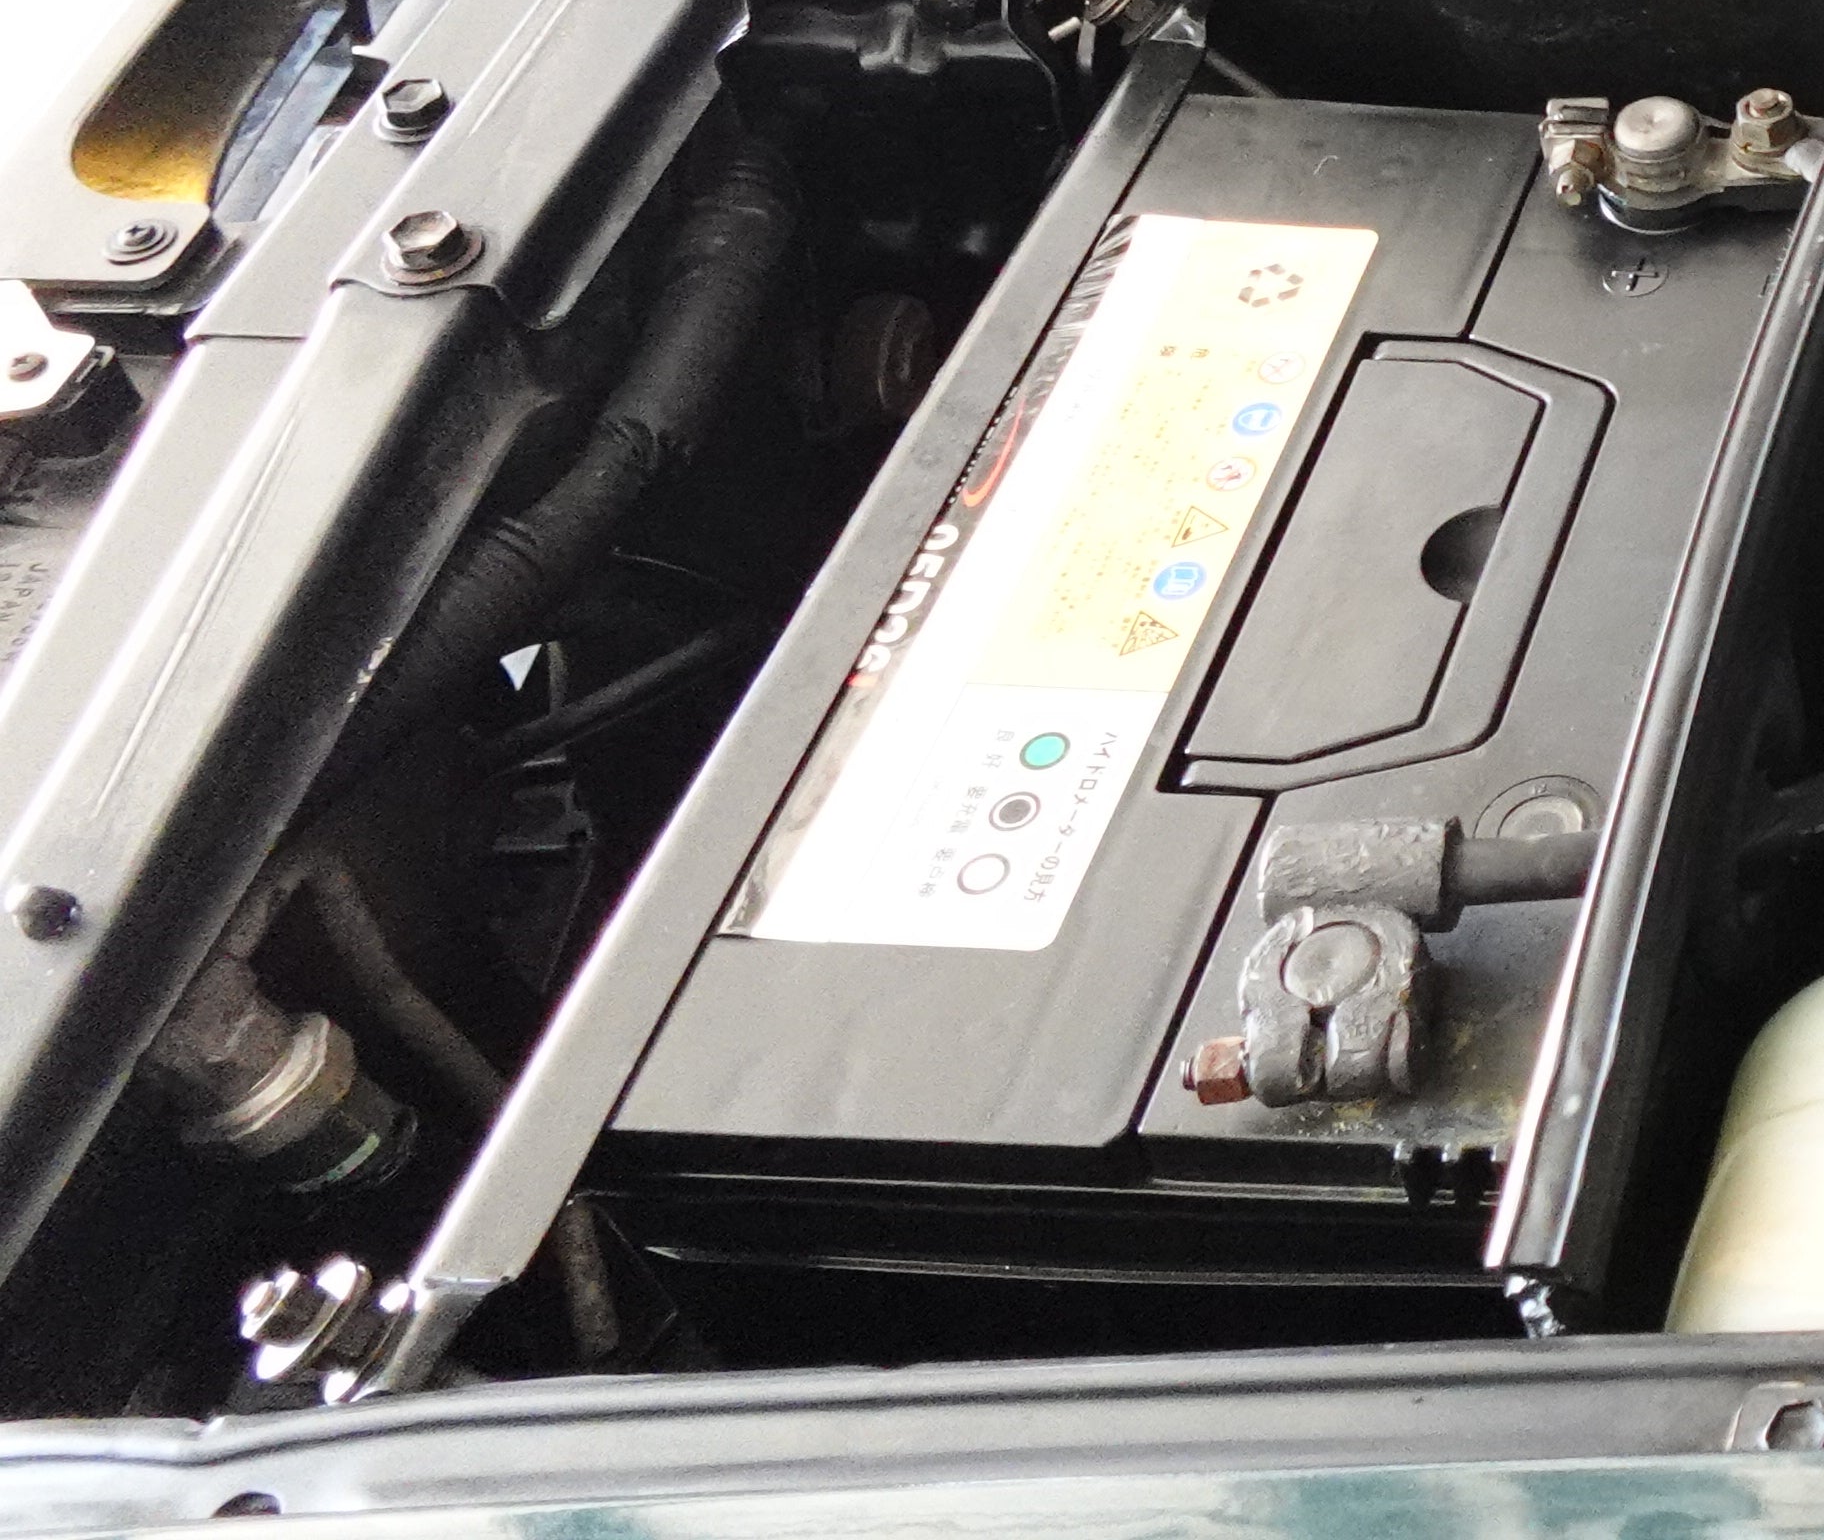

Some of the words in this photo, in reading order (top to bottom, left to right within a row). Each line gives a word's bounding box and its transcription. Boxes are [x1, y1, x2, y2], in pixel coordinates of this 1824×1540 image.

[1023, 731, 1118, 903] ハイドロメーターの見方
